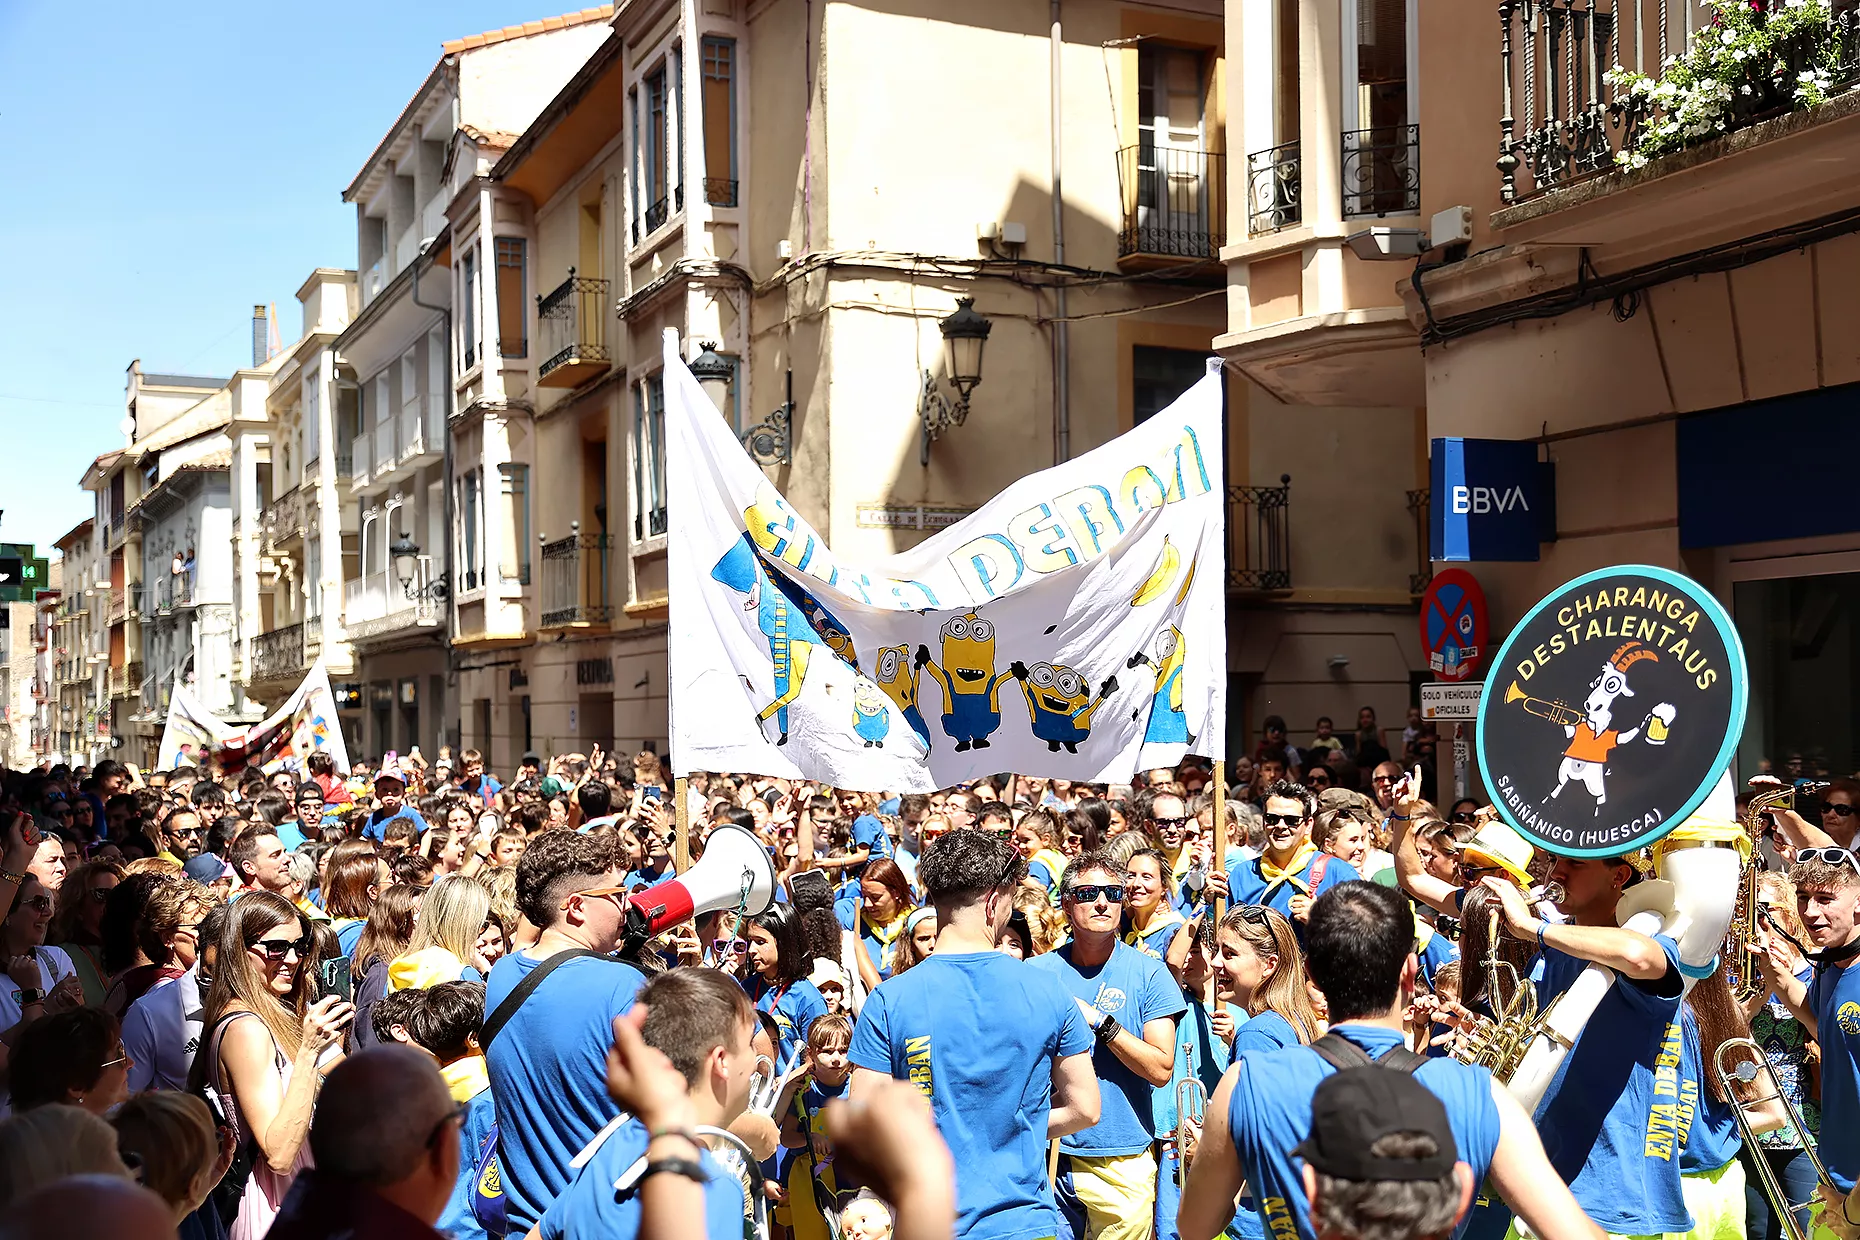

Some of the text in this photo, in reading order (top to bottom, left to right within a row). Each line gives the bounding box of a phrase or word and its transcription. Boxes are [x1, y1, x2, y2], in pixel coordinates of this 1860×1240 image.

[1452, 485, 1529, 514] BBVA
[1557, 587, 1700, 633] CHARANGA
[1516, 616, 1717, 690] DESTALENTAUS
[1423, 691, 1440, 700] SOLO
[1435, 705, 1471, 715] OFICIALES
[1498, 775, 1662, 846] SABIÑÁNIGO (HUESCA)
[905, 1034, 933, 1104] EBAN
[1644, 1021, 1683, 1162] ENTA DEBAN
